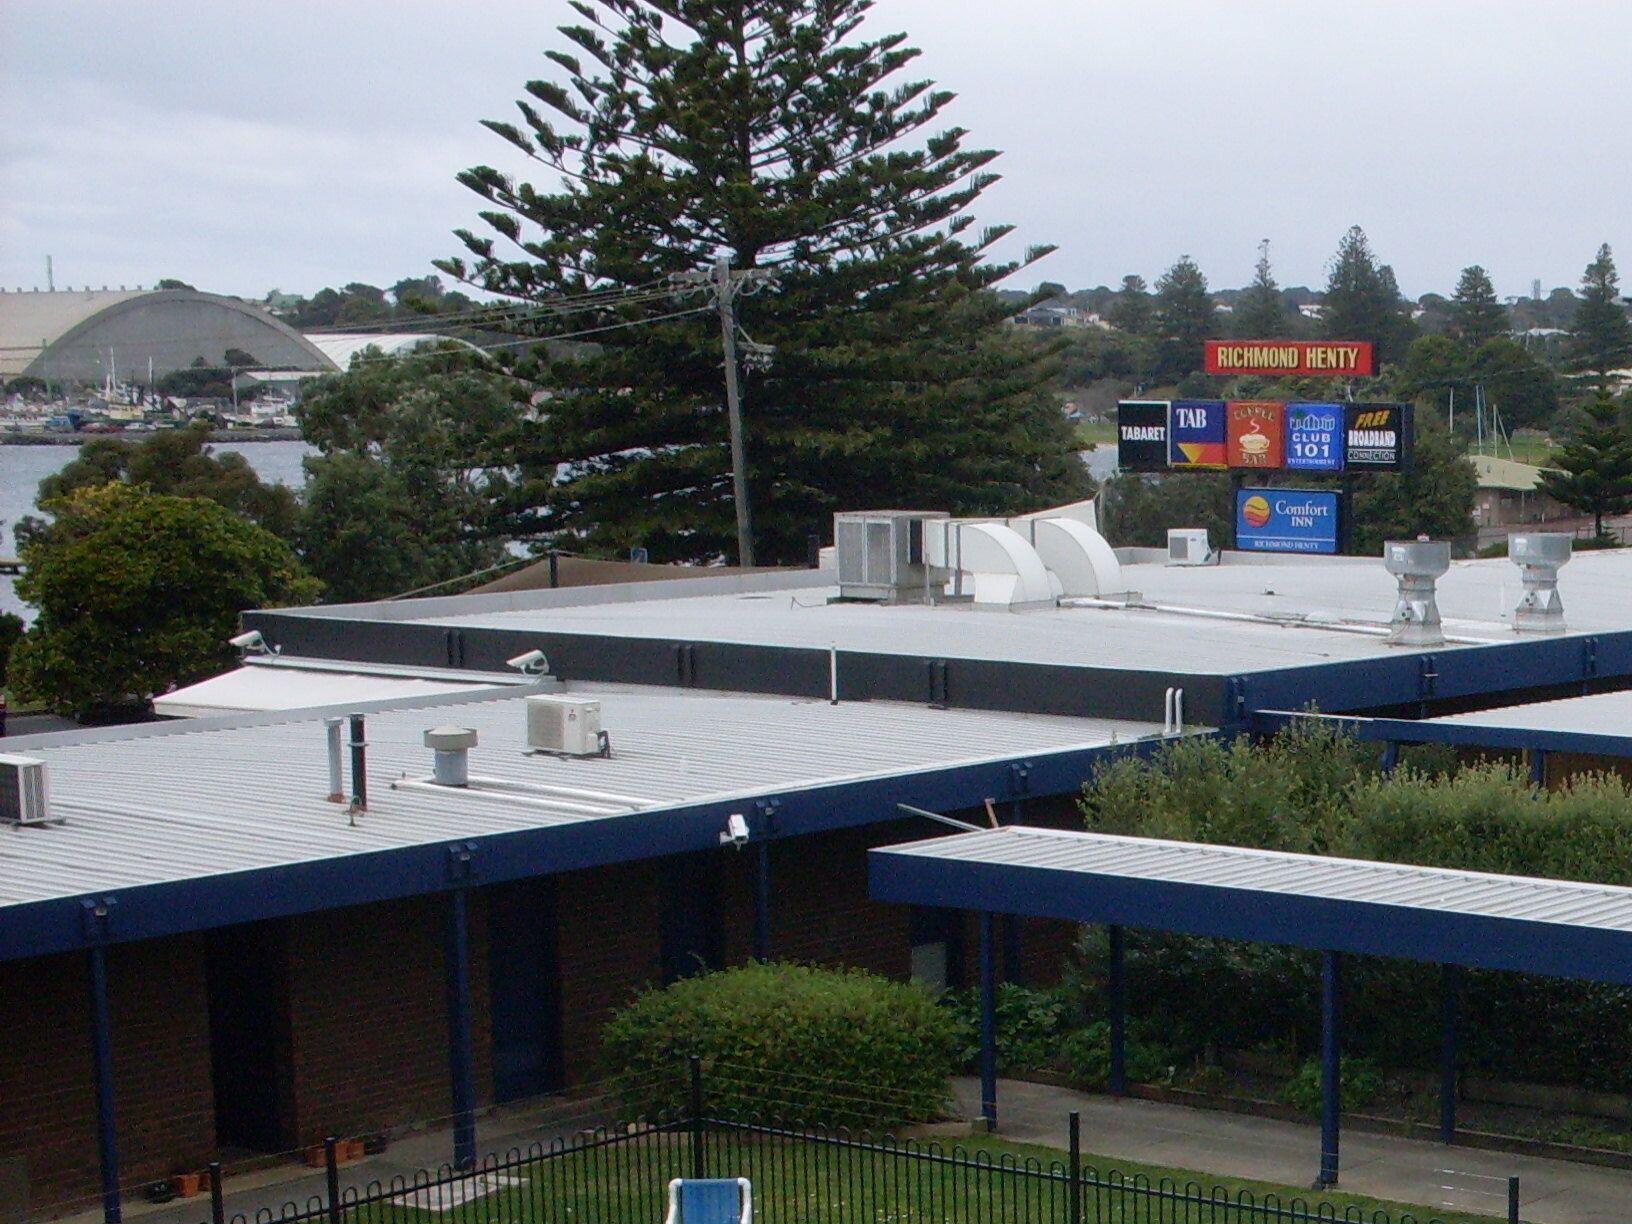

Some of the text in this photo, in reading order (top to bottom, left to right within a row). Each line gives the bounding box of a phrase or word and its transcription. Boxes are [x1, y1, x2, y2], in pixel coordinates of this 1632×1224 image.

[1217, 346, 1358, 368] RICHMOND HENTY
[1176, 408, 1207, 428] TAB
[1355, 410, 1390, 427] FREE
[1121, 426, 1165, 441] TABARET
[1292, 433, 1331, 442] CLUB
[1348, 430, 1396, 447] BROADBAND
[1294, 444, 1330, 457] 101
[1347, 450, 1395, 461] CONNECTION
[1242, 453, 1267, 465] BAR
[1275, 501, 1328, 516] Comfort
[1291, 516, 1313, 528] INN
[1254, 540, 1319, 550] RICHMOND HENTY
